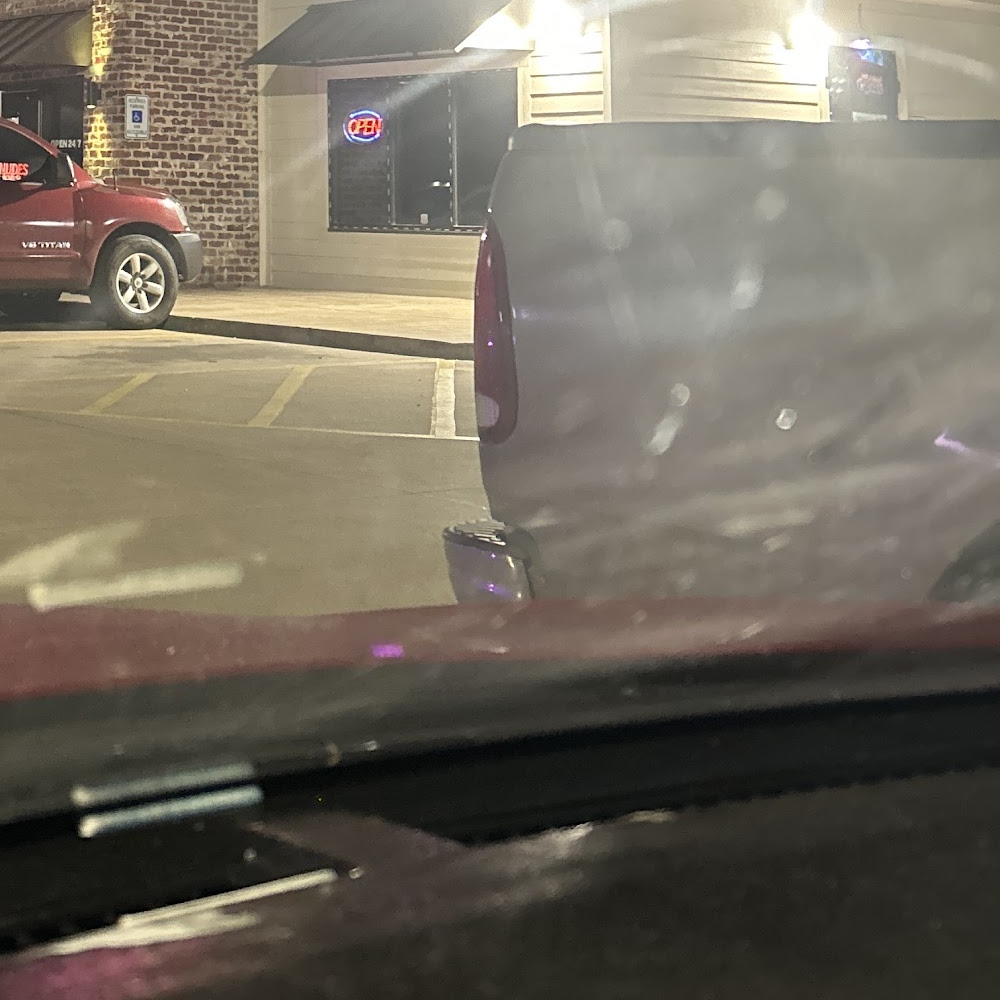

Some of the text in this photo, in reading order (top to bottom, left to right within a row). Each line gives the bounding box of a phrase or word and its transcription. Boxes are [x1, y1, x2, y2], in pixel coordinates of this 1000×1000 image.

[348, 117, 383, 135] OPEN
[0, 162, 29, 176] NUDES
[37, 241, 71, 249] TITAN
